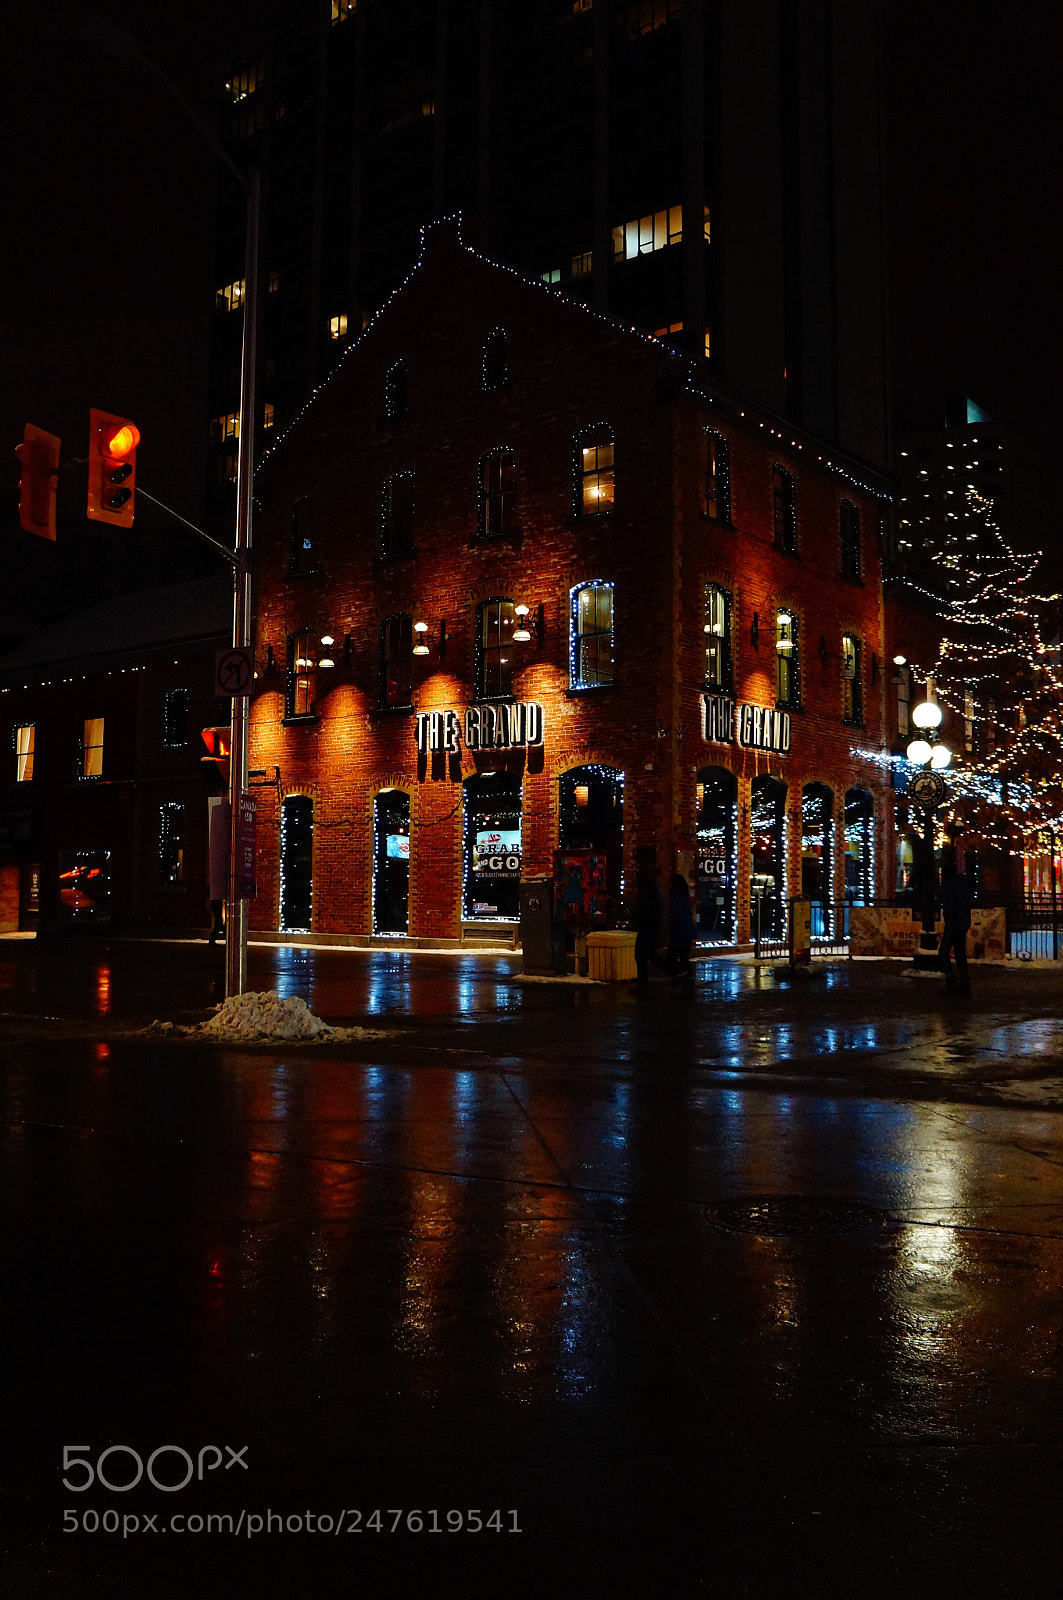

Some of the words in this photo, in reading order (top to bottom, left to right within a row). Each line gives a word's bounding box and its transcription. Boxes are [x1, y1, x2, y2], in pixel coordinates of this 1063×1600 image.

[416, 711, 452, 750] THE
[465, 702, 541, 747] GRAND
[703, 694, 734, 742] THE
[742, 704, 791, 751] GRAND
[244, 812, 252, 823] 150
[475, 844, 520, 855] GRAB
[704, 859, 726, 874] GO
[893, 931, 920, 940] PRICE
